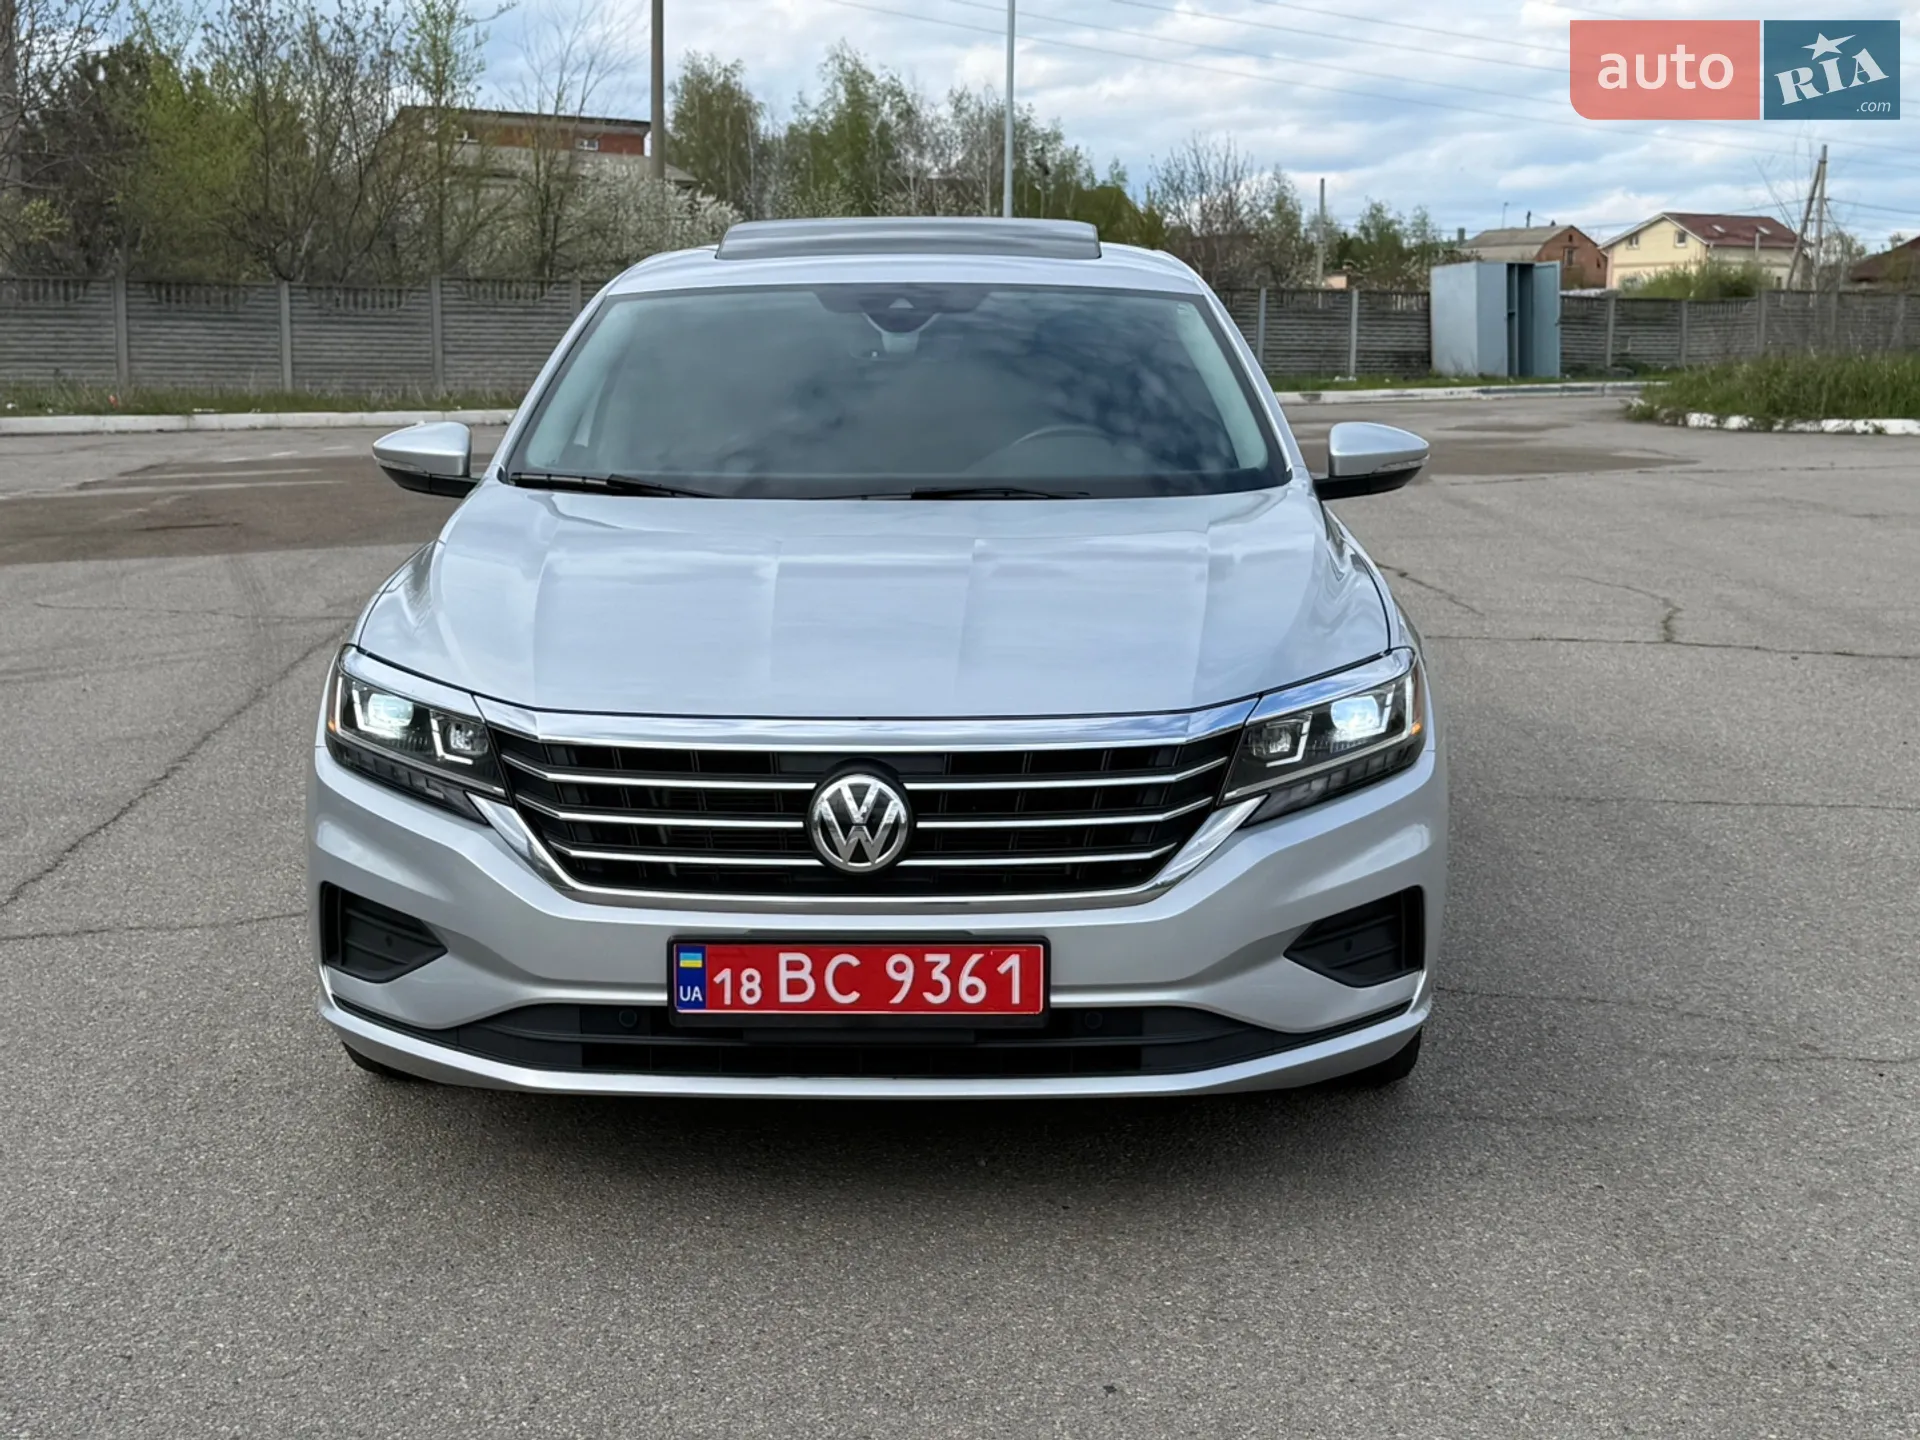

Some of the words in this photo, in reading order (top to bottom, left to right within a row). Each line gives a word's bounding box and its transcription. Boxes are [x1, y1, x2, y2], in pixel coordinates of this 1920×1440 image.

[679, 986, 703, 1001] UA
[713, 968, 762, 1005] 18
[778, 952, 860, 1004] BC
[885, 953, 1021, 1005] 9361
